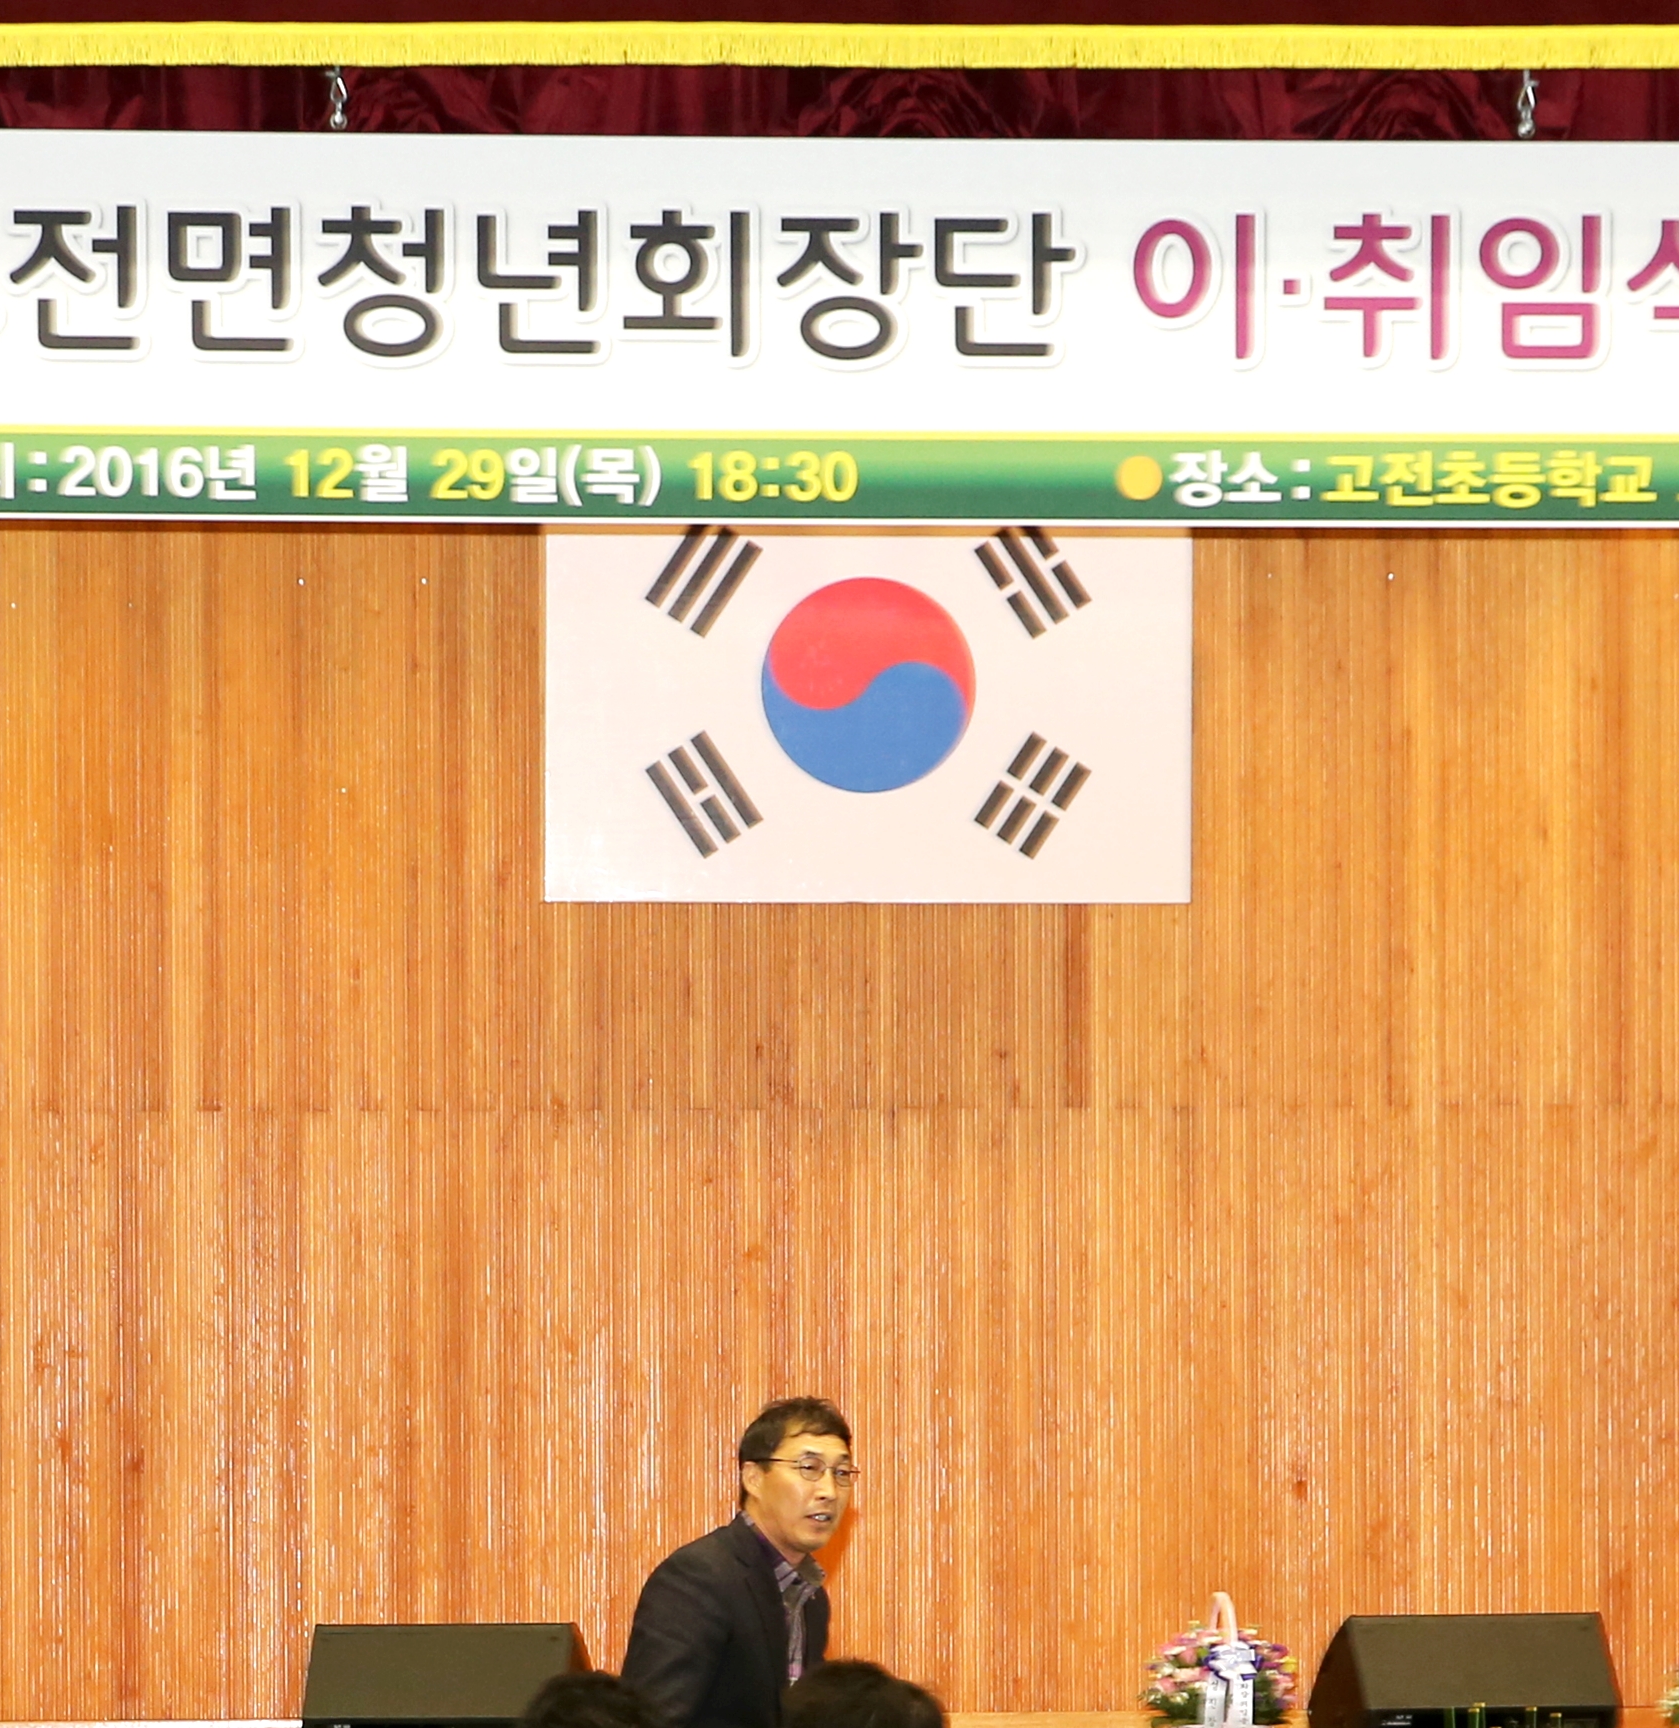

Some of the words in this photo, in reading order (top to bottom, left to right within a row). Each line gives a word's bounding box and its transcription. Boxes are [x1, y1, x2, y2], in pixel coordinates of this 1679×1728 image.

[57, 444, 258, 501] 2016년
[282, 444, 409, 503] 12월
[430, 445, 662, 507] 29일(목)
[687, 450, 859, 502] 18:30
[1321, 450, 1658, 508] 고전초등학교
